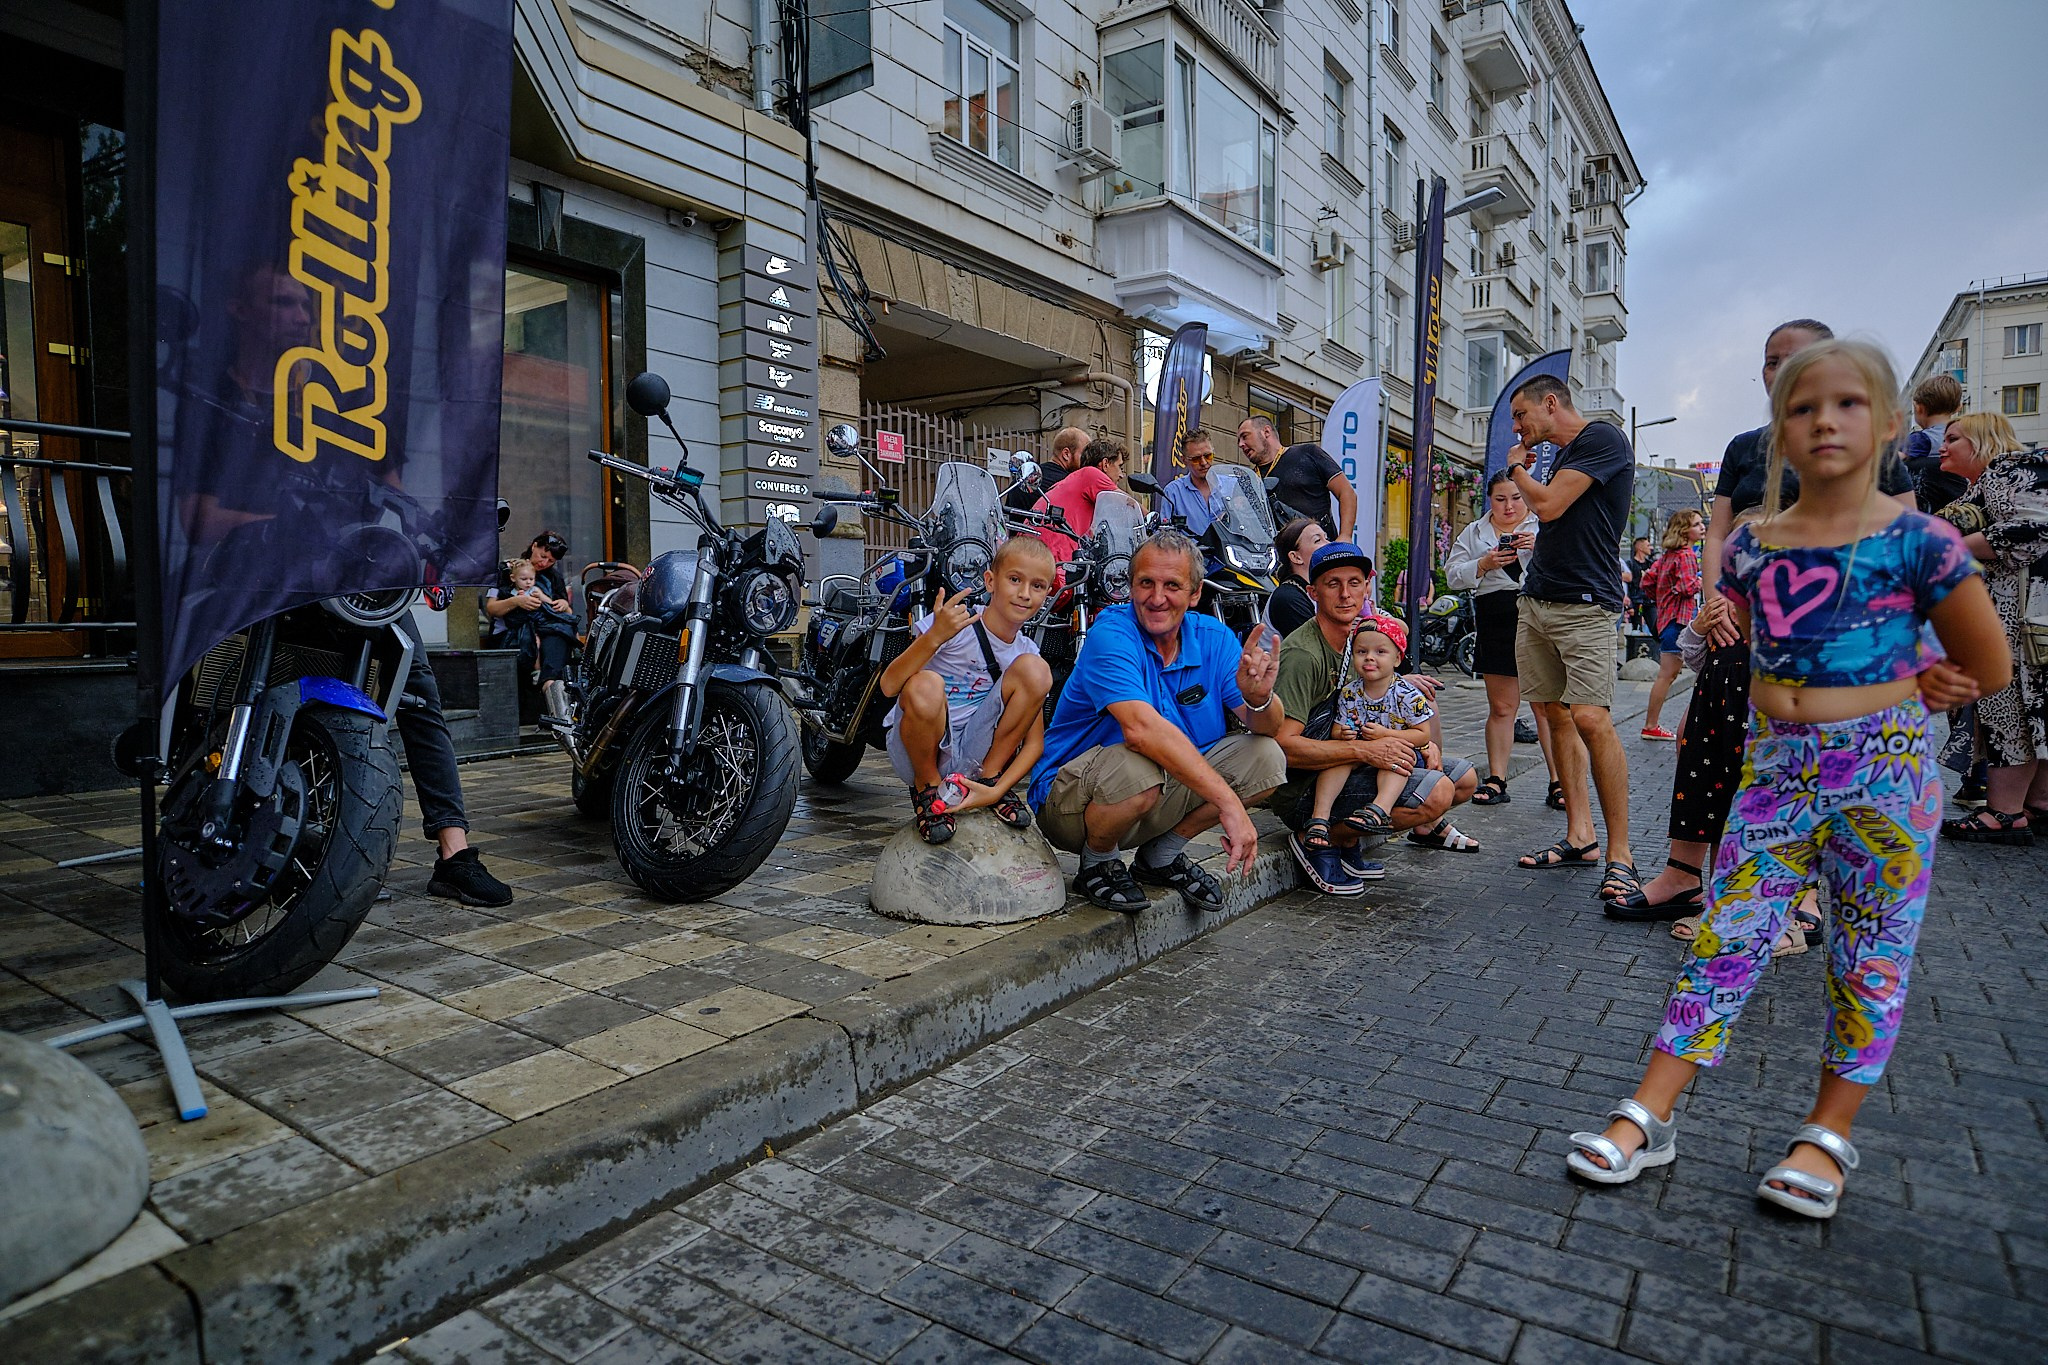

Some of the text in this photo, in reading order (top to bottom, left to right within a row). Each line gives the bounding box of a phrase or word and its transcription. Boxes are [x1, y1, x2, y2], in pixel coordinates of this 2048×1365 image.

[273, 28, 423, 463] Rolling
[785, 406, 809, 417] balance
[758, 420, 797, 439] Saucony
[754, 480, 801, 494] CONVERSE
[1745, 825, 1790, 841] NICE
